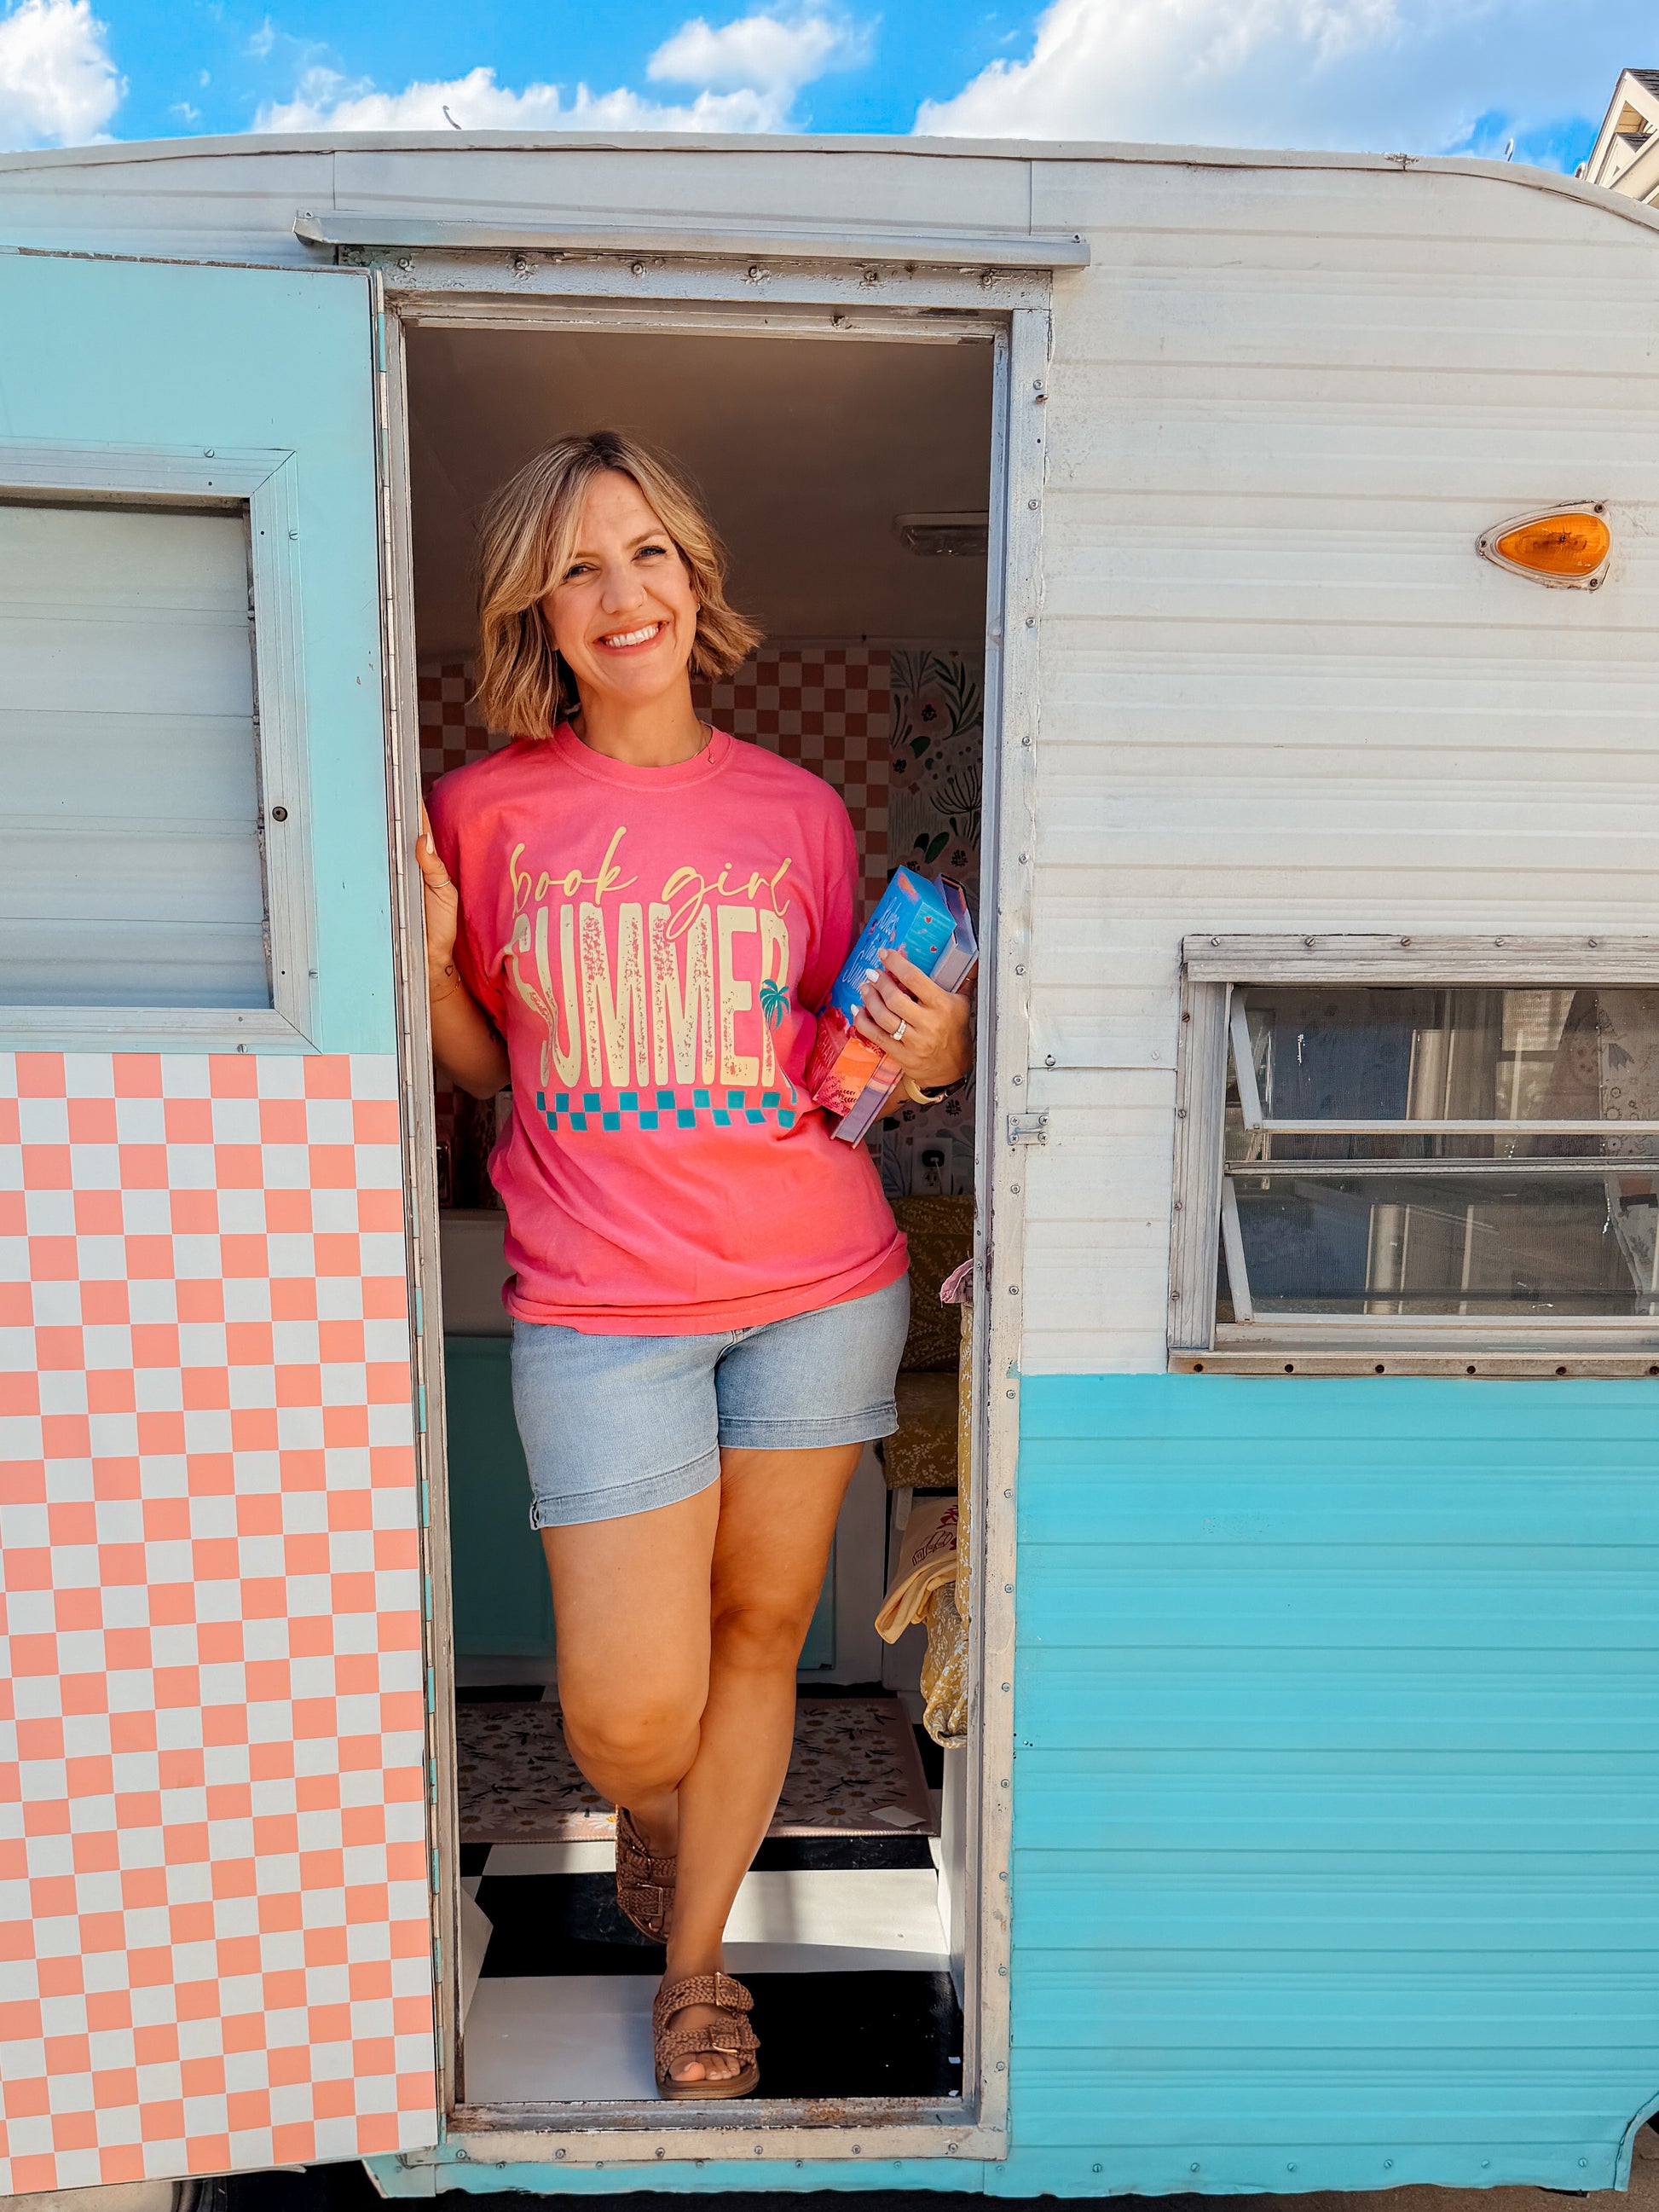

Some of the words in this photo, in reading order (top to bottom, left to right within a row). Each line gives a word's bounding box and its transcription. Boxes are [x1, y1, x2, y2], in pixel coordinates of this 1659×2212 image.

[509, 825, 639, 919] book
[661, 857, 792, 942] girl
[503, 901, 793, 1088] SUMMER
